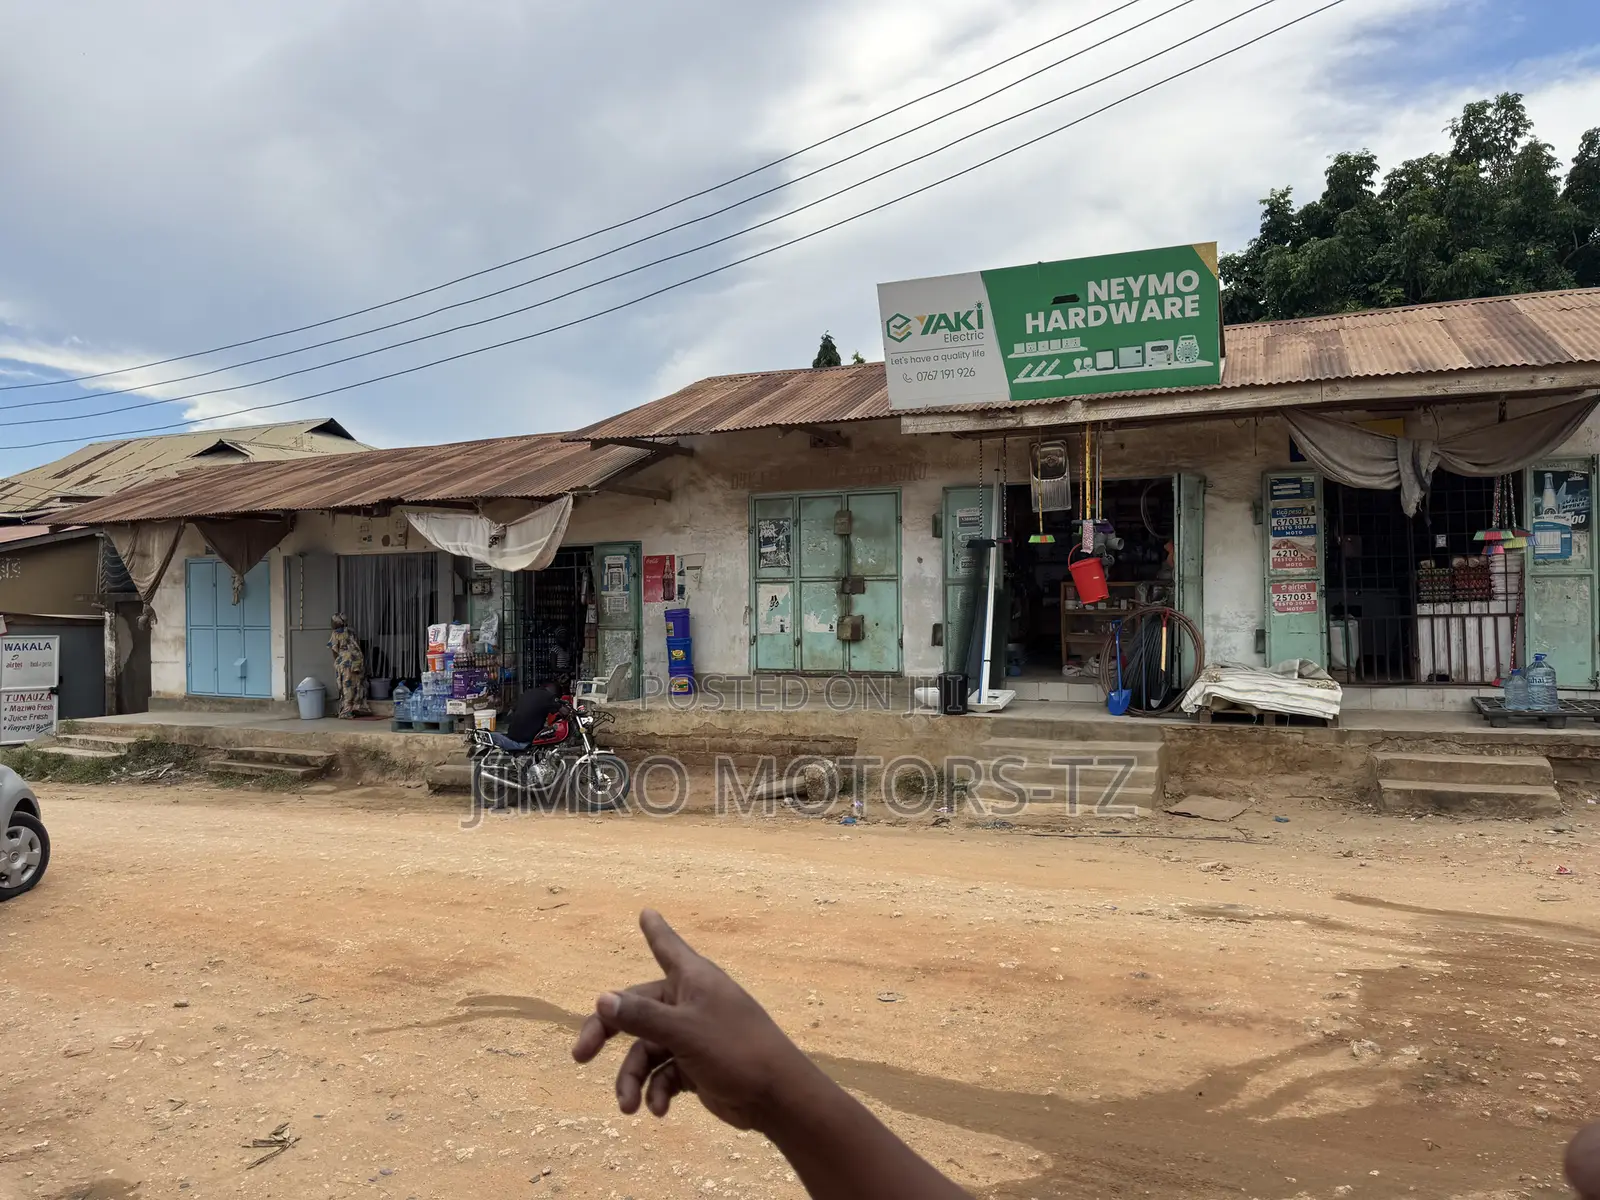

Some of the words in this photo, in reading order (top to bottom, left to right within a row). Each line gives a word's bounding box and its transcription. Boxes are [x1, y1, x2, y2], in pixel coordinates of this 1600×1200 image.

[1087, 269, 1200, 303] NEYMO
[1025, 294, 1200, 334] HARDWARE
[944, 330, 984, 343] Electric
[891, 356, 909, 366] Let's
[910, 354, 931, 364] have
[933, 354, 939, 362] a
[941, 351, 970, 363] quality
[972, 349, 985, 358] life
[916, 370, 938, 382] 0767
[940, 369, 955, 380] 191
[957, 367, 976, 378] 926
[1276, 517, 1310, 526] 670317
[1571, 514, 1586, 525] 00
[1276, 549, 1303, 558] 4210
[1276, 593, 1312, 602] 257003
[4, 642, 52, 652] WAKALA
[5, 693, 52, 702] TUNAUZA
[9, 705, 36, 713] Maziwa
[37, 703, 54, 711] Fresh
[8, 714, 28, 723] Juice
[29, 713, 49, 721] Fresh
